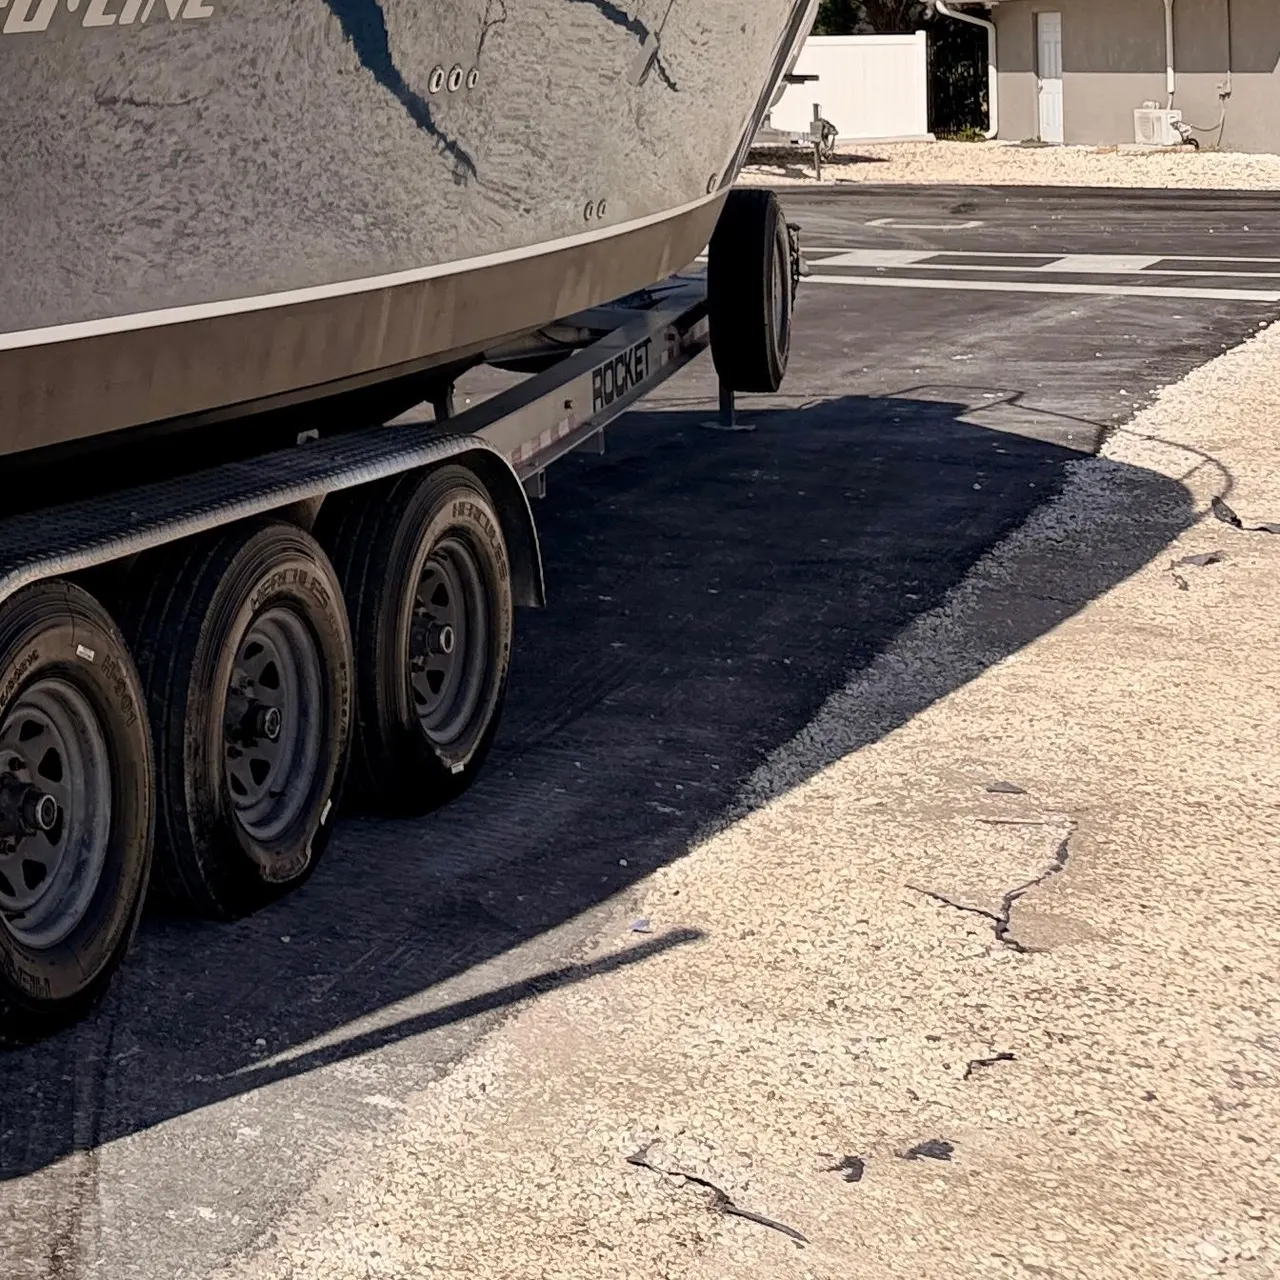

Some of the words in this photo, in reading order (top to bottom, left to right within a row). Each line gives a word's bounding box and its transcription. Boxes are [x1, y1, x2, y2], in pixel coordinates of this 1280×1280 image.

[592, 336, 652, 414] ROCKET
[452, 501, 507, 581] HERCULES
[251, 567, 330, 611] HERCULES
